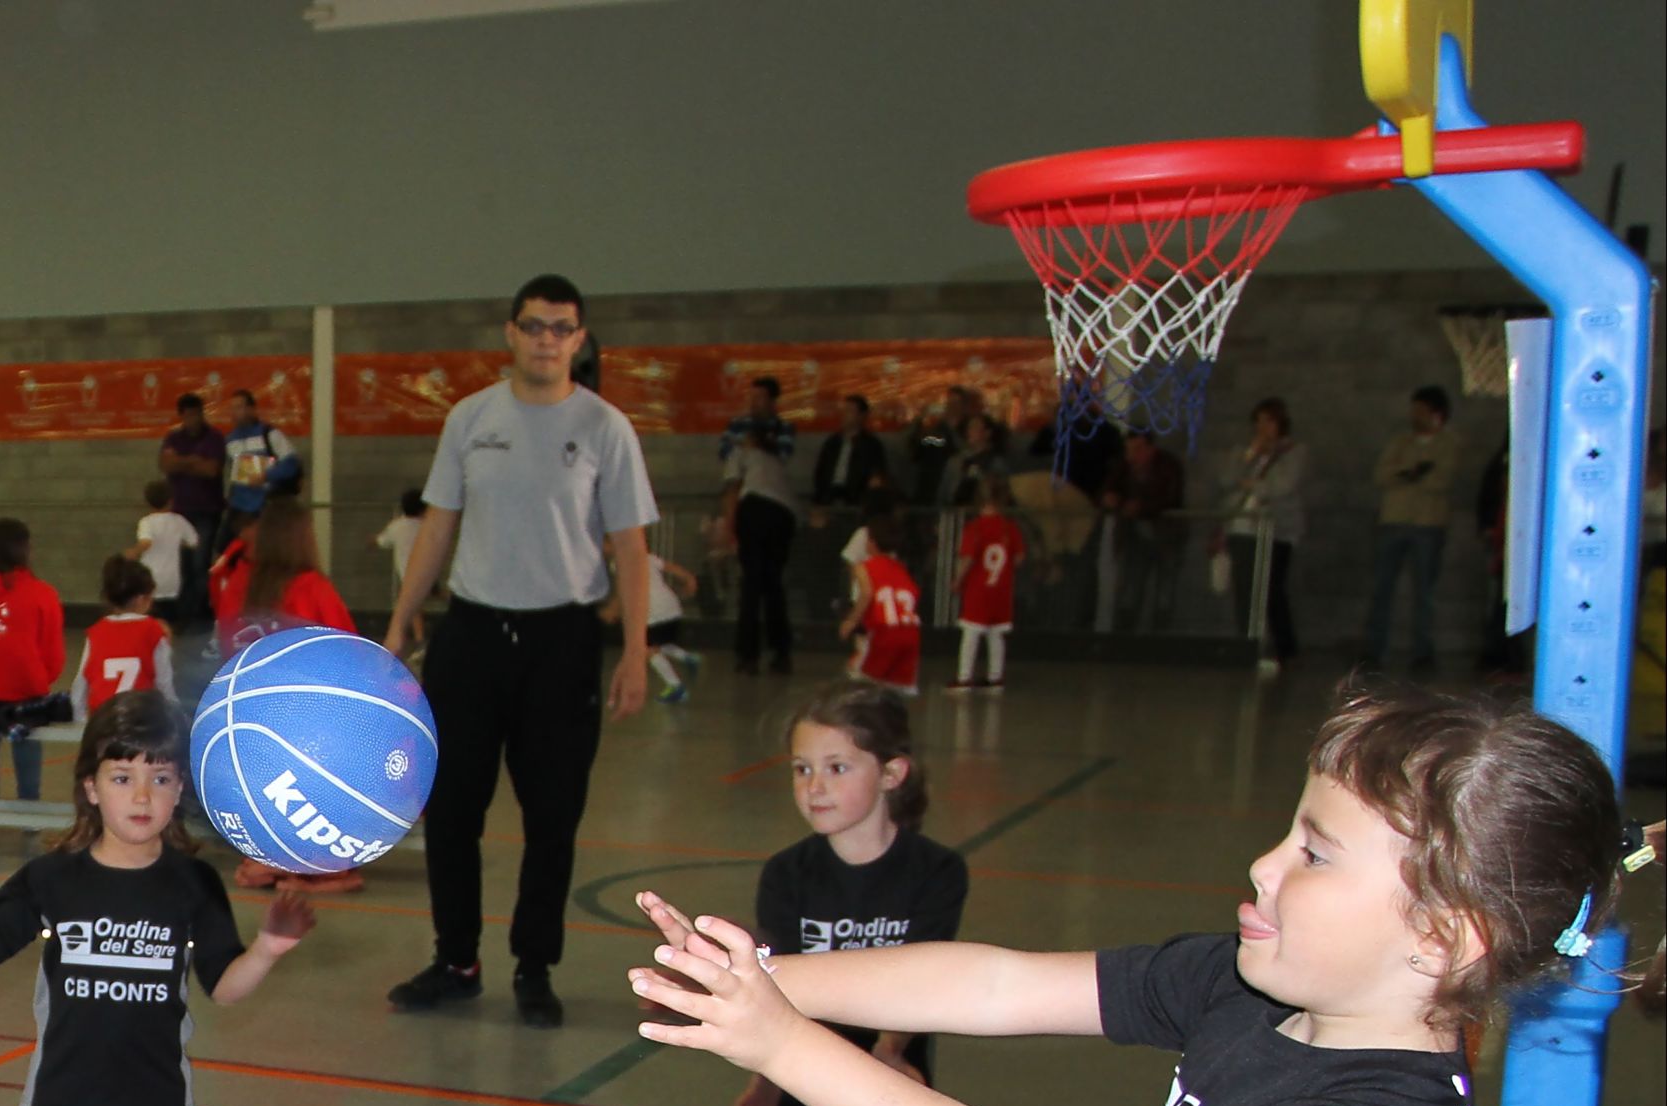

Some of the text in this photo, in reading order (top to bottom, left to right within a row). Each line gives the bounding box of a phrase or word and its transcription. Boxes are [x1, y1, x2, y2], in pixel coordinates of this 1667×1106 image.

[983, 543, 1007, 586] 9
[876, 586, 920, 626] 13
[103, 656, 140, 694] 7
[94, 917, 171, 941] Ondina
[99, 938, 176, 959] del Segre
[64, 977, 168, 1002] CB PONTS
